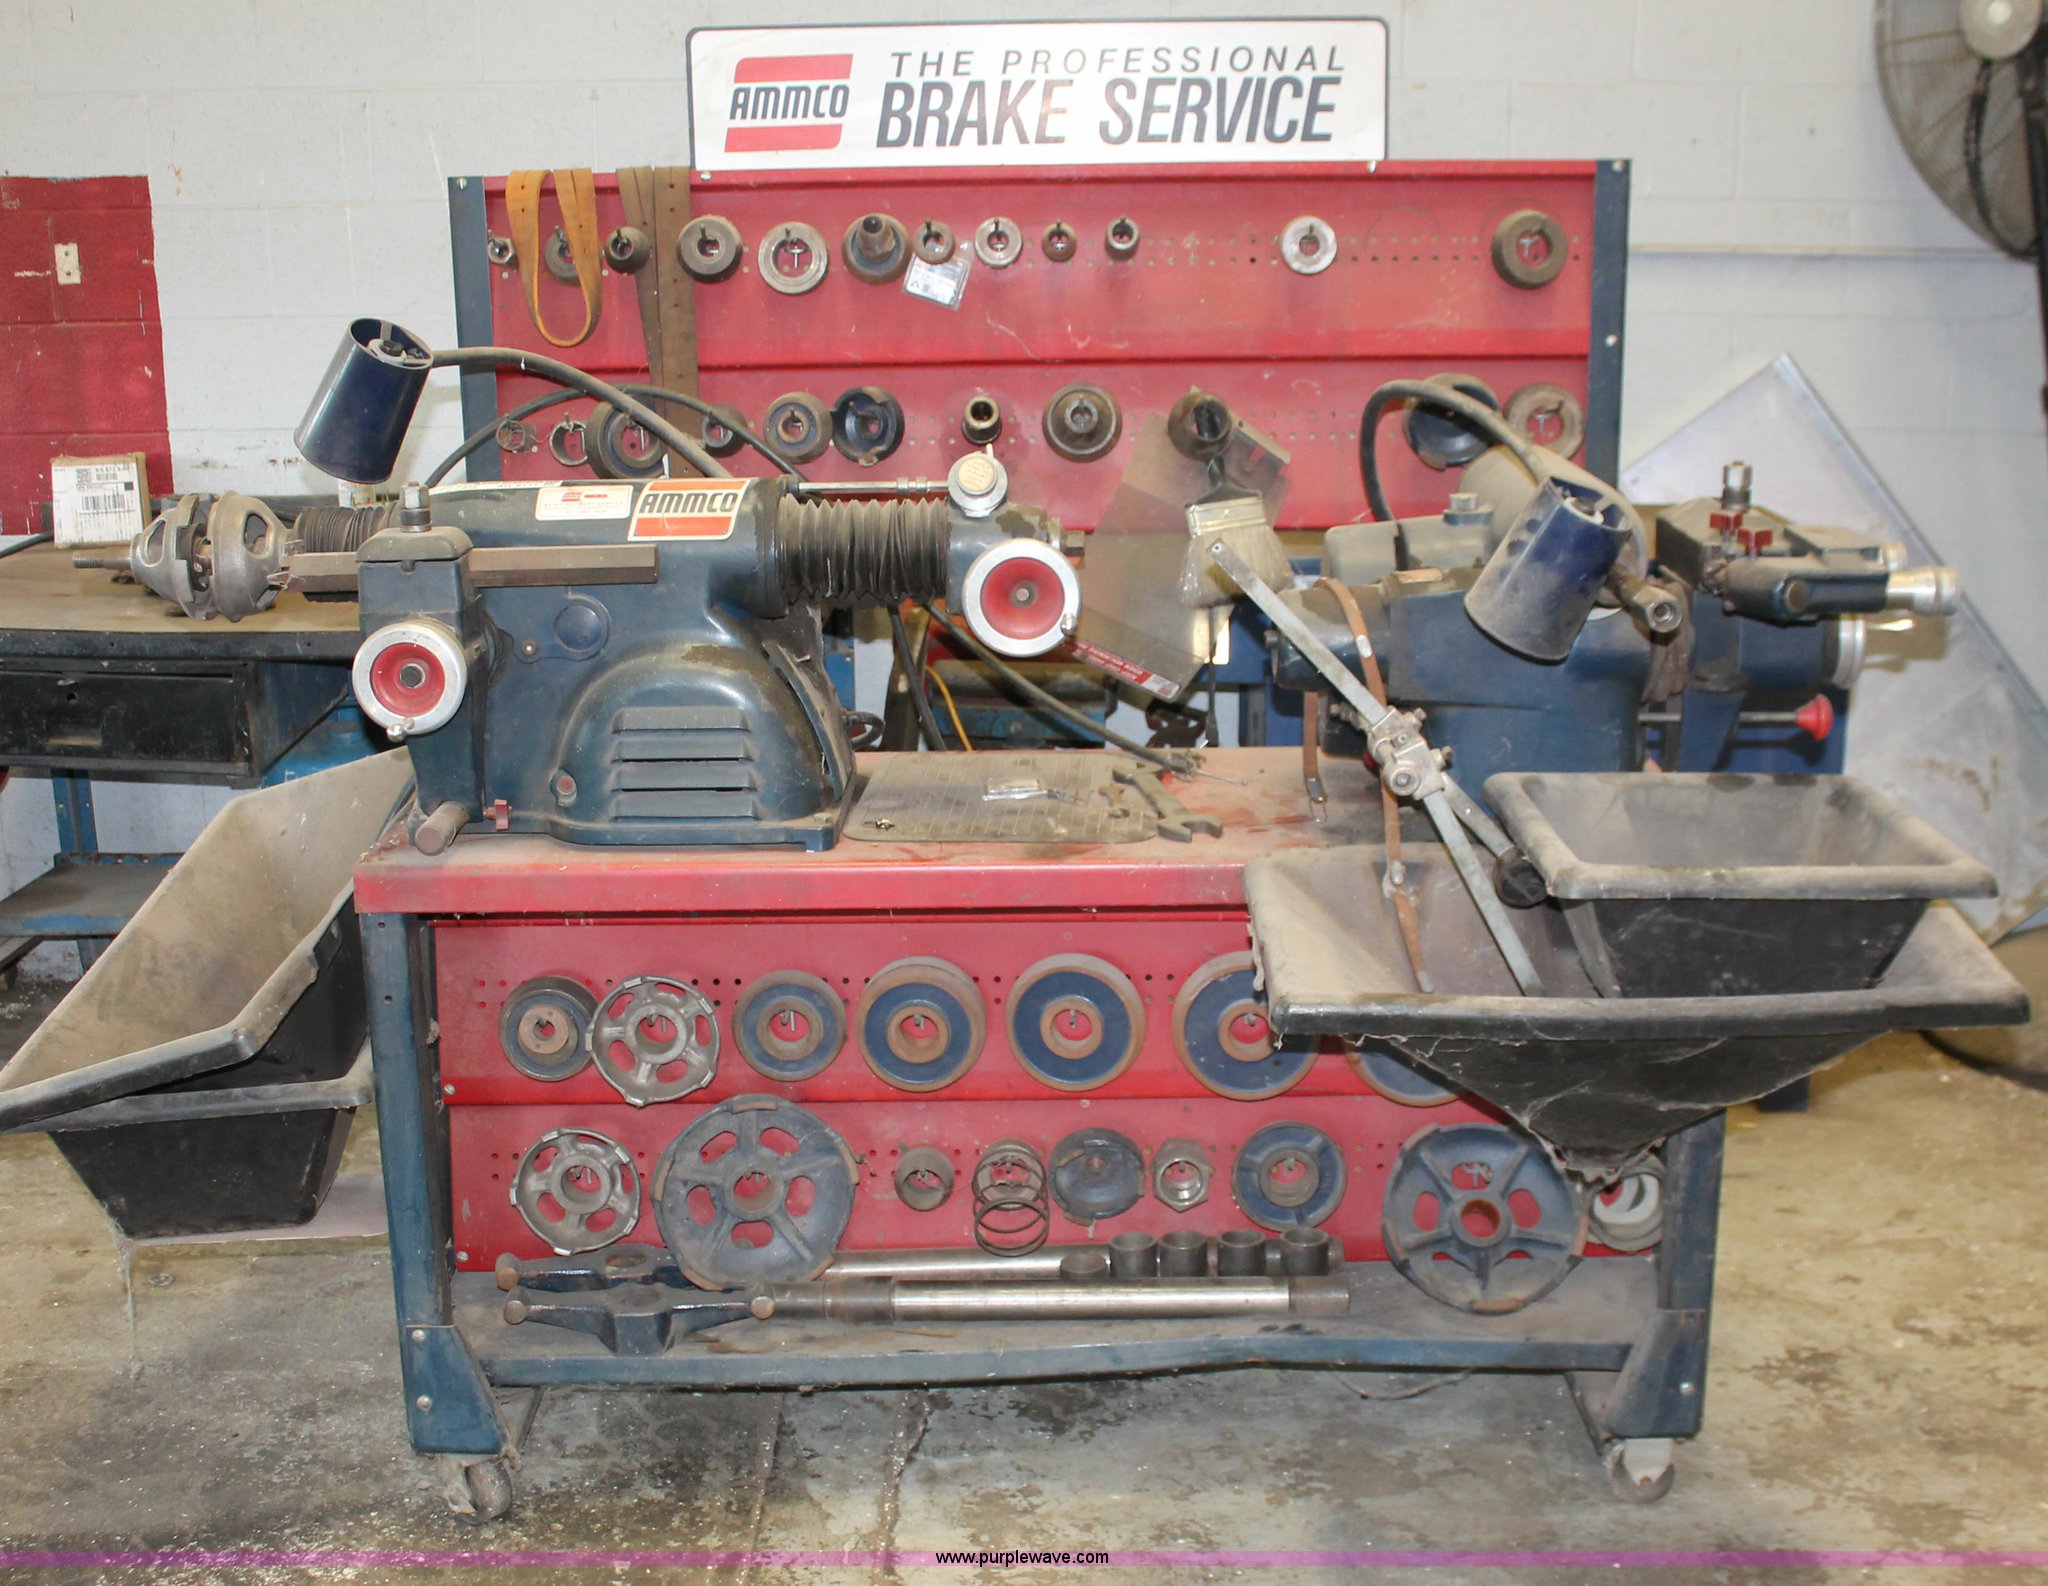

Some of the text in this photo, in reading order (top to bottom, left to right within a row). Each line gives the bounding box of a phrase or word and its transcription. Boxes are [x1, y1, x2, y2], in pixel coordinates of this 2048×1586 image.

[891, 46, 1346, 79] THE PROFESSIONAL
[729, 83, 849, 121] AMMCO
[876, 75, 1342, 149] BRAKE SERVICE
[639, 492, 739, 514] AMMCO
